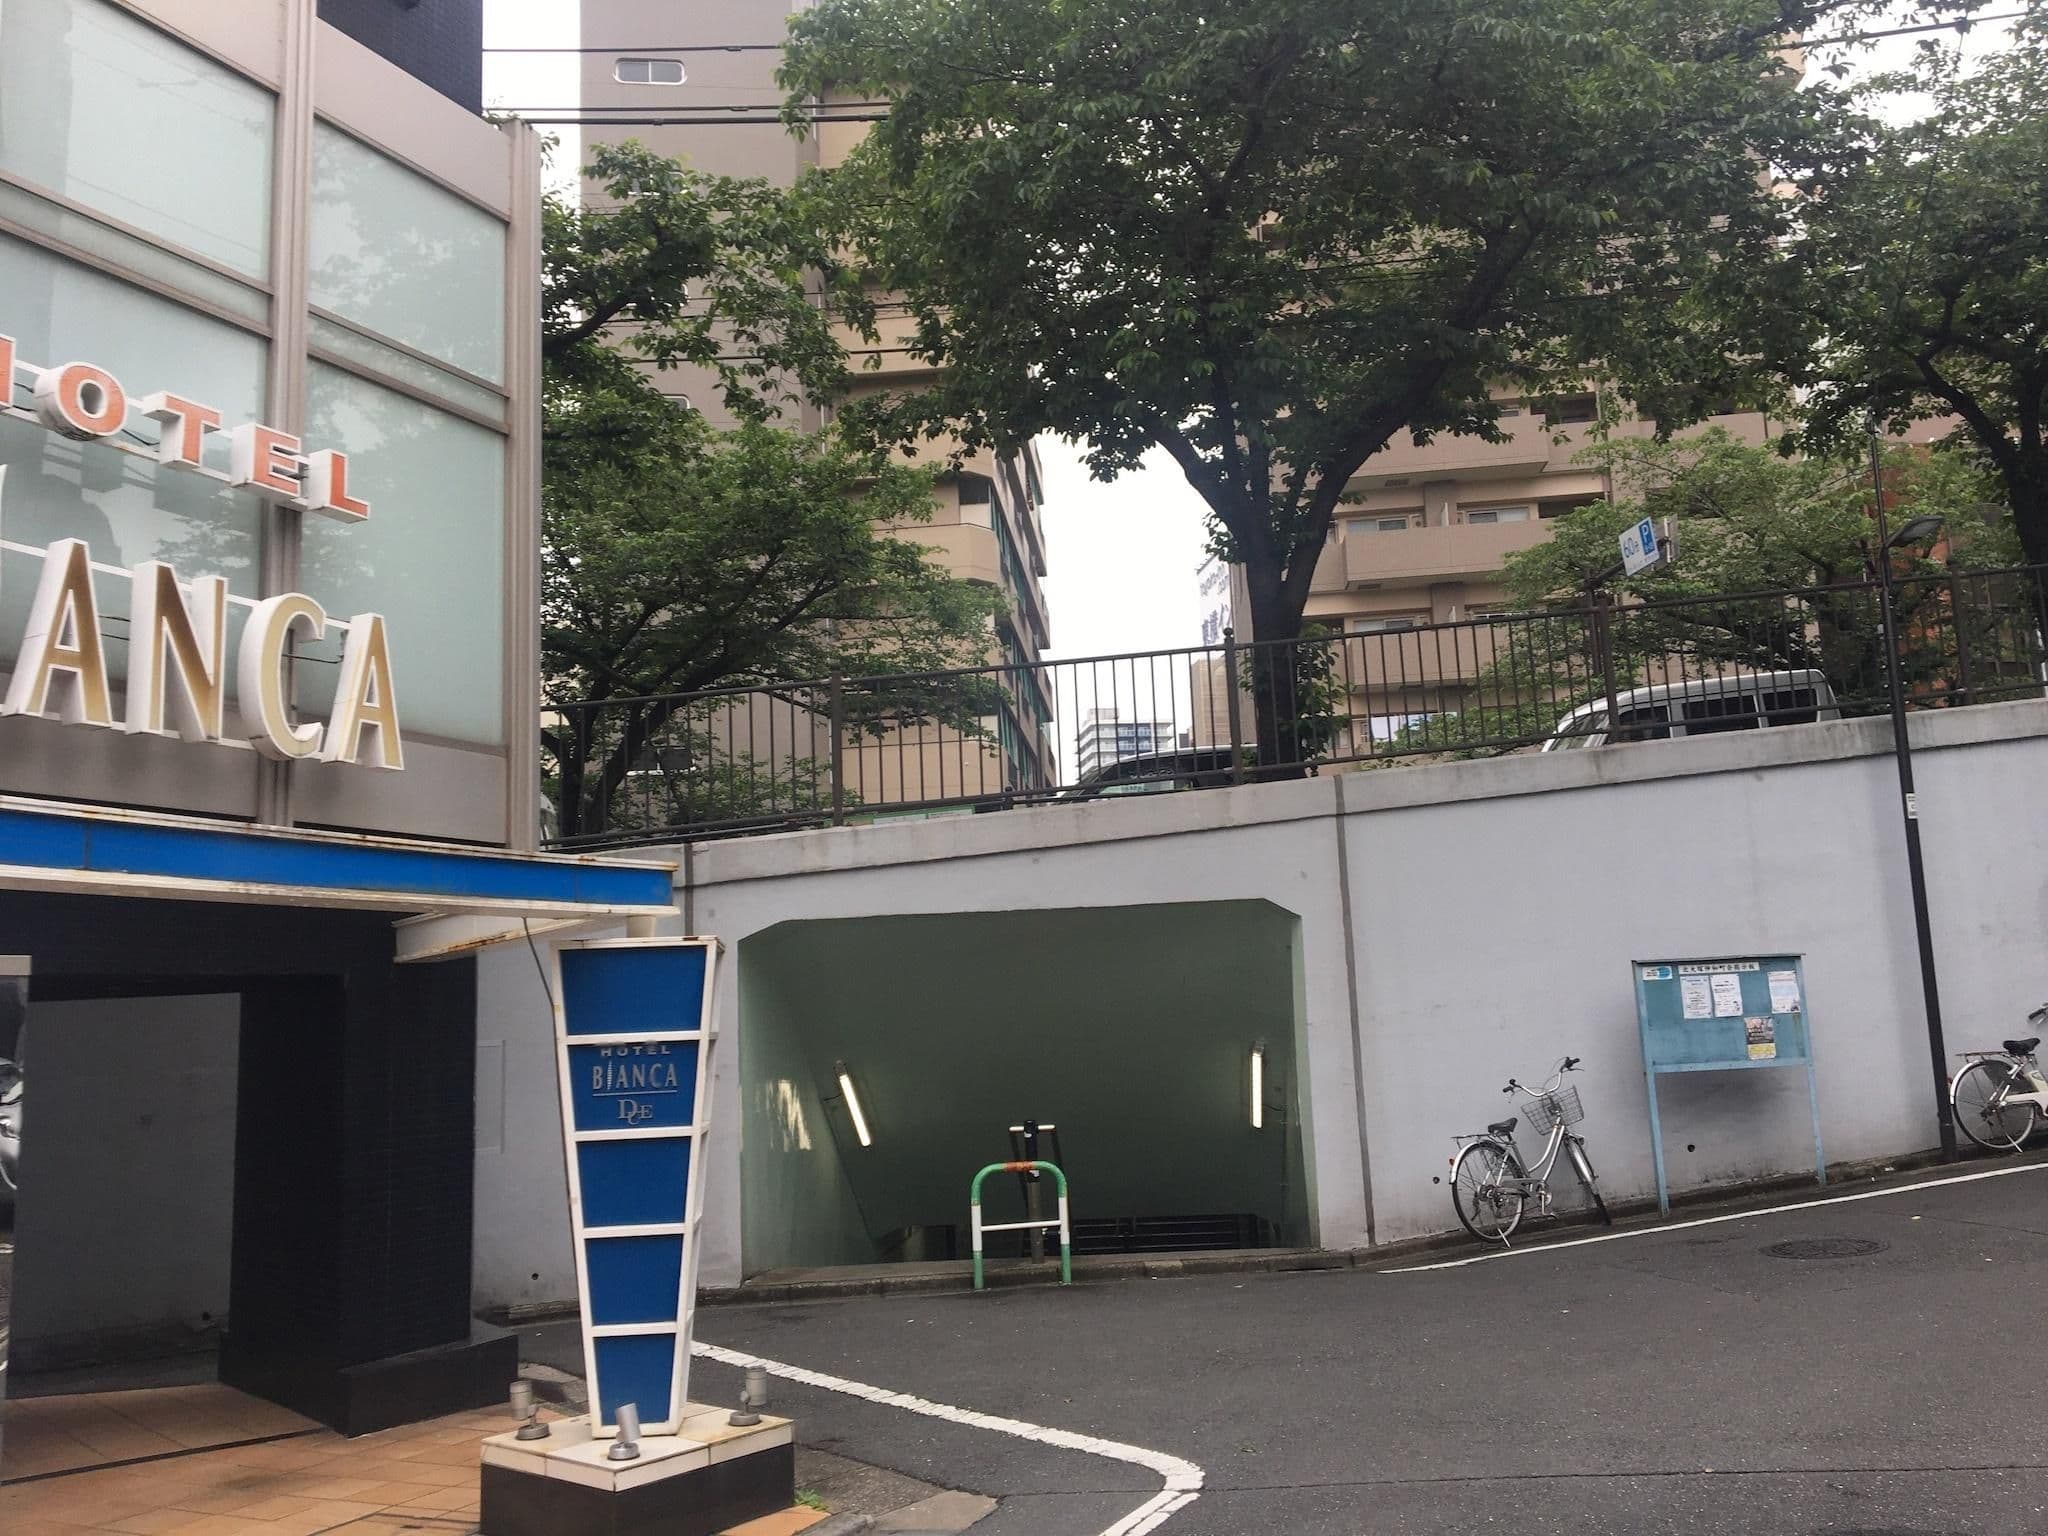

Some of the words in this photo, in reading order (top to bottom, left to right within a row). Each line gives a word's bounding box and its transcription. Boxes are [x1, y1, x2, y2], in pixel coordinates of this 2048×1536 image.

[1641, 524, 1650, 543] P
[0, 538, 404, 771] ANCA
[600, 1045, 671, 1057] HOTEL
[592, 1061, 678, 1090] BIANCA
